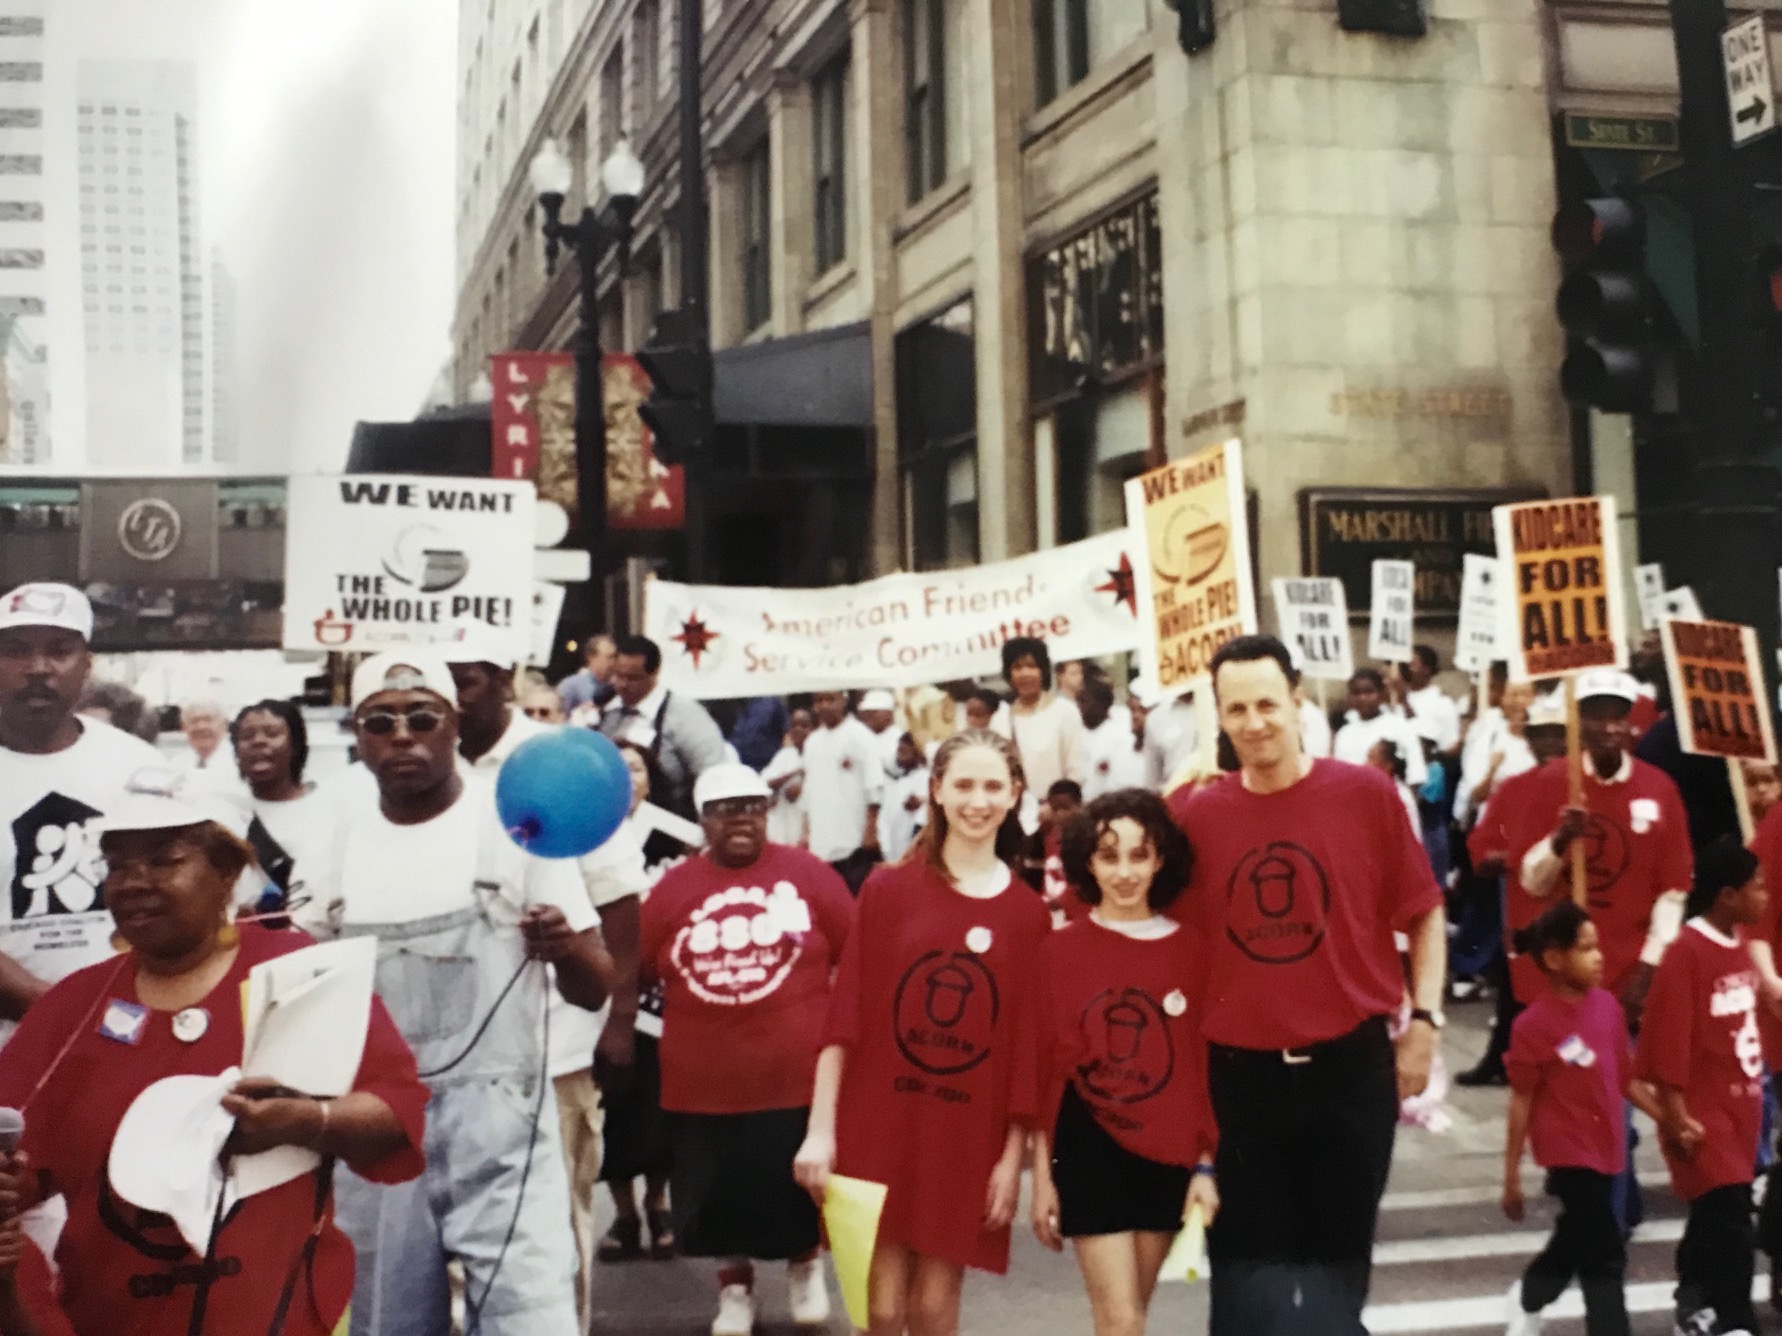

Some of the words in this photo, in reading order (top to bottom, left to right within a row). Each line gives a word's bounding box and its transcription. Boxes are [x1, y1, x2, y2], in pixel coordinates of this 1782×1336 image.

[1728, 24, 1760, 63] ONE
[1729, 60, 1763, 95] WAY
[506, 361, 530, 478] LYRI
[339, 481, 420, 507] WE
[427, 489, 515, 513] WANT
[1142, 466, 1179, 505] WE
[1326, 509, 1449, 542] MARSHALL
[336, 573, 385, 595] THE
[1519, 556, 1600, 594] FOR
[342, 597, 442, 624] WHOLE
[451, 596, 513, 627] PIE!
[1523, 596, 1609, 651] ALL!
[1682, 664, 1751, 697] FOR
